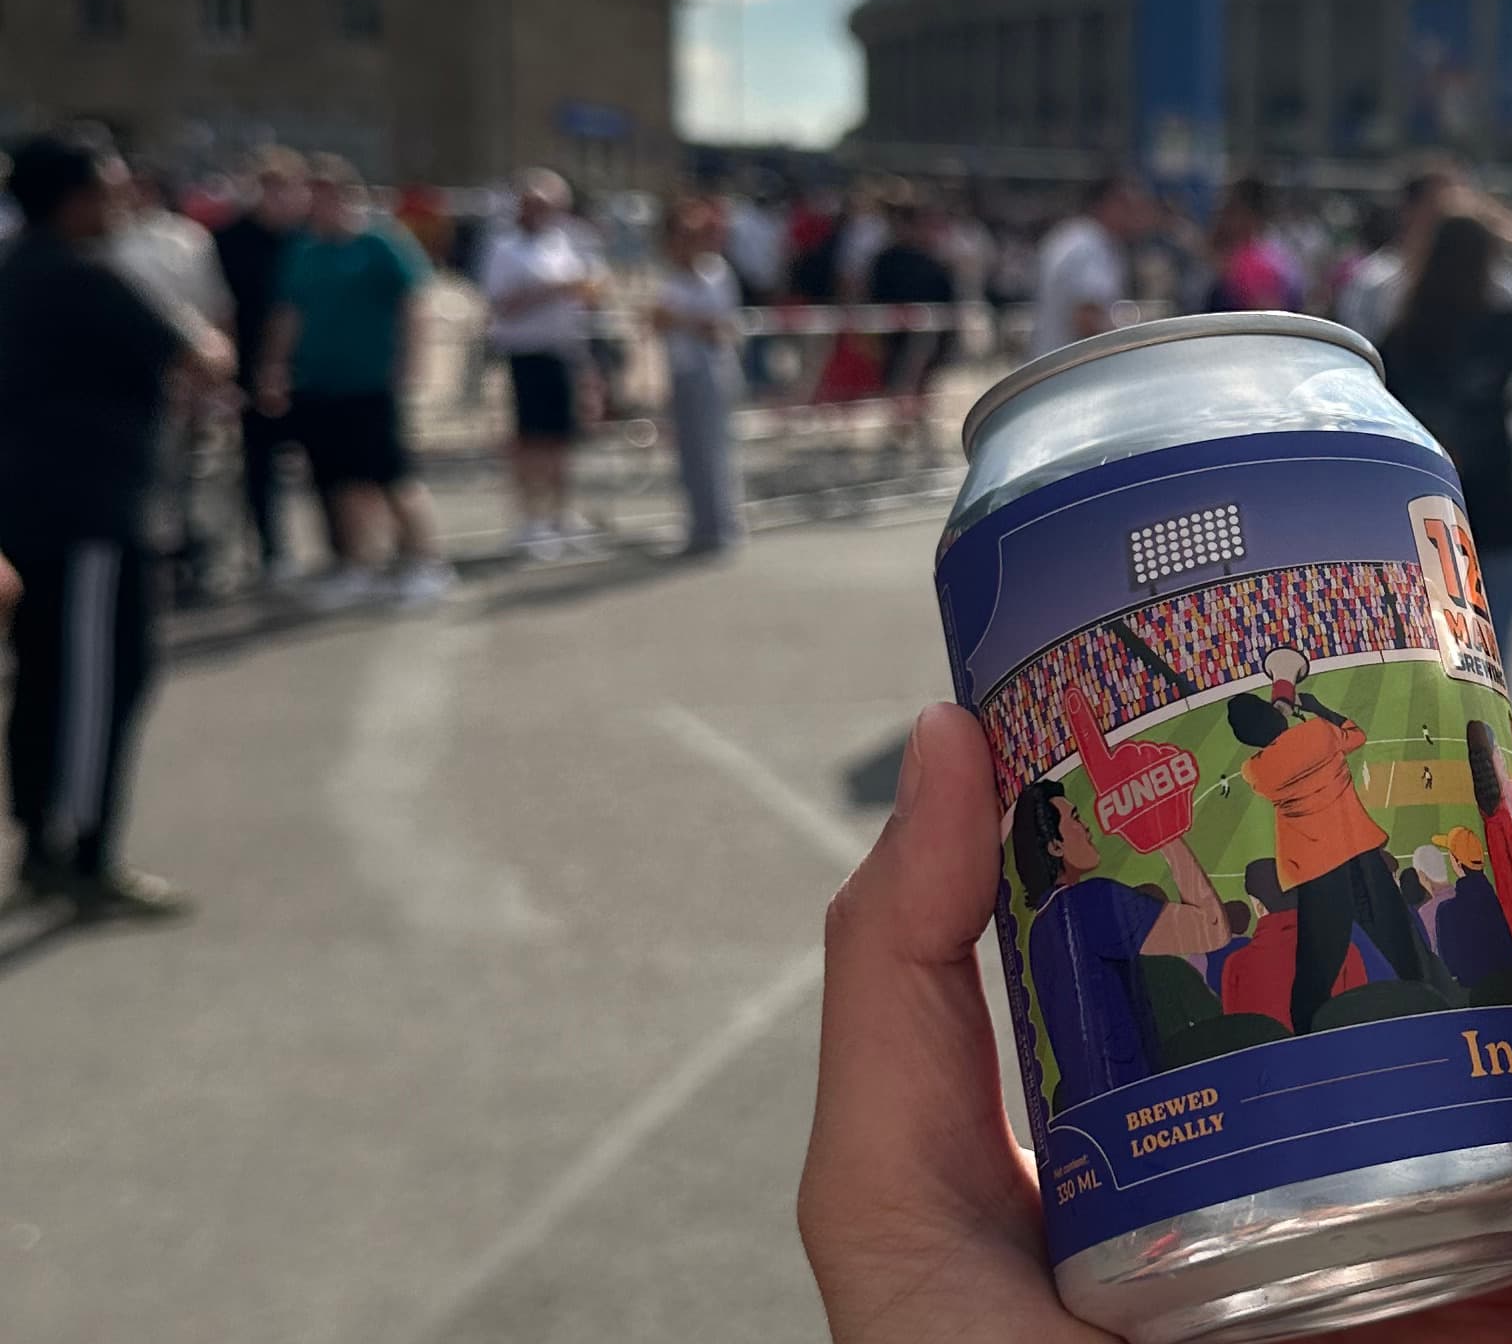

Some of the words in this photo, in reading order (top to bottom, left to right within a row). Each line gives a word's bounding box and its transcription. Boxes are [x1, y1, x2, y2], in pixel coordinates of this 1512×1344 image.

[1097, 752, 1198, 831] FUN88
[1125, 1087, 1219, 1131] BREWED
[1130, 1112, 1225, 1158] LOCALLY
[1056, 1178, 1076, 1206] 330
[1077, 1168, 1103, 1194] ML
